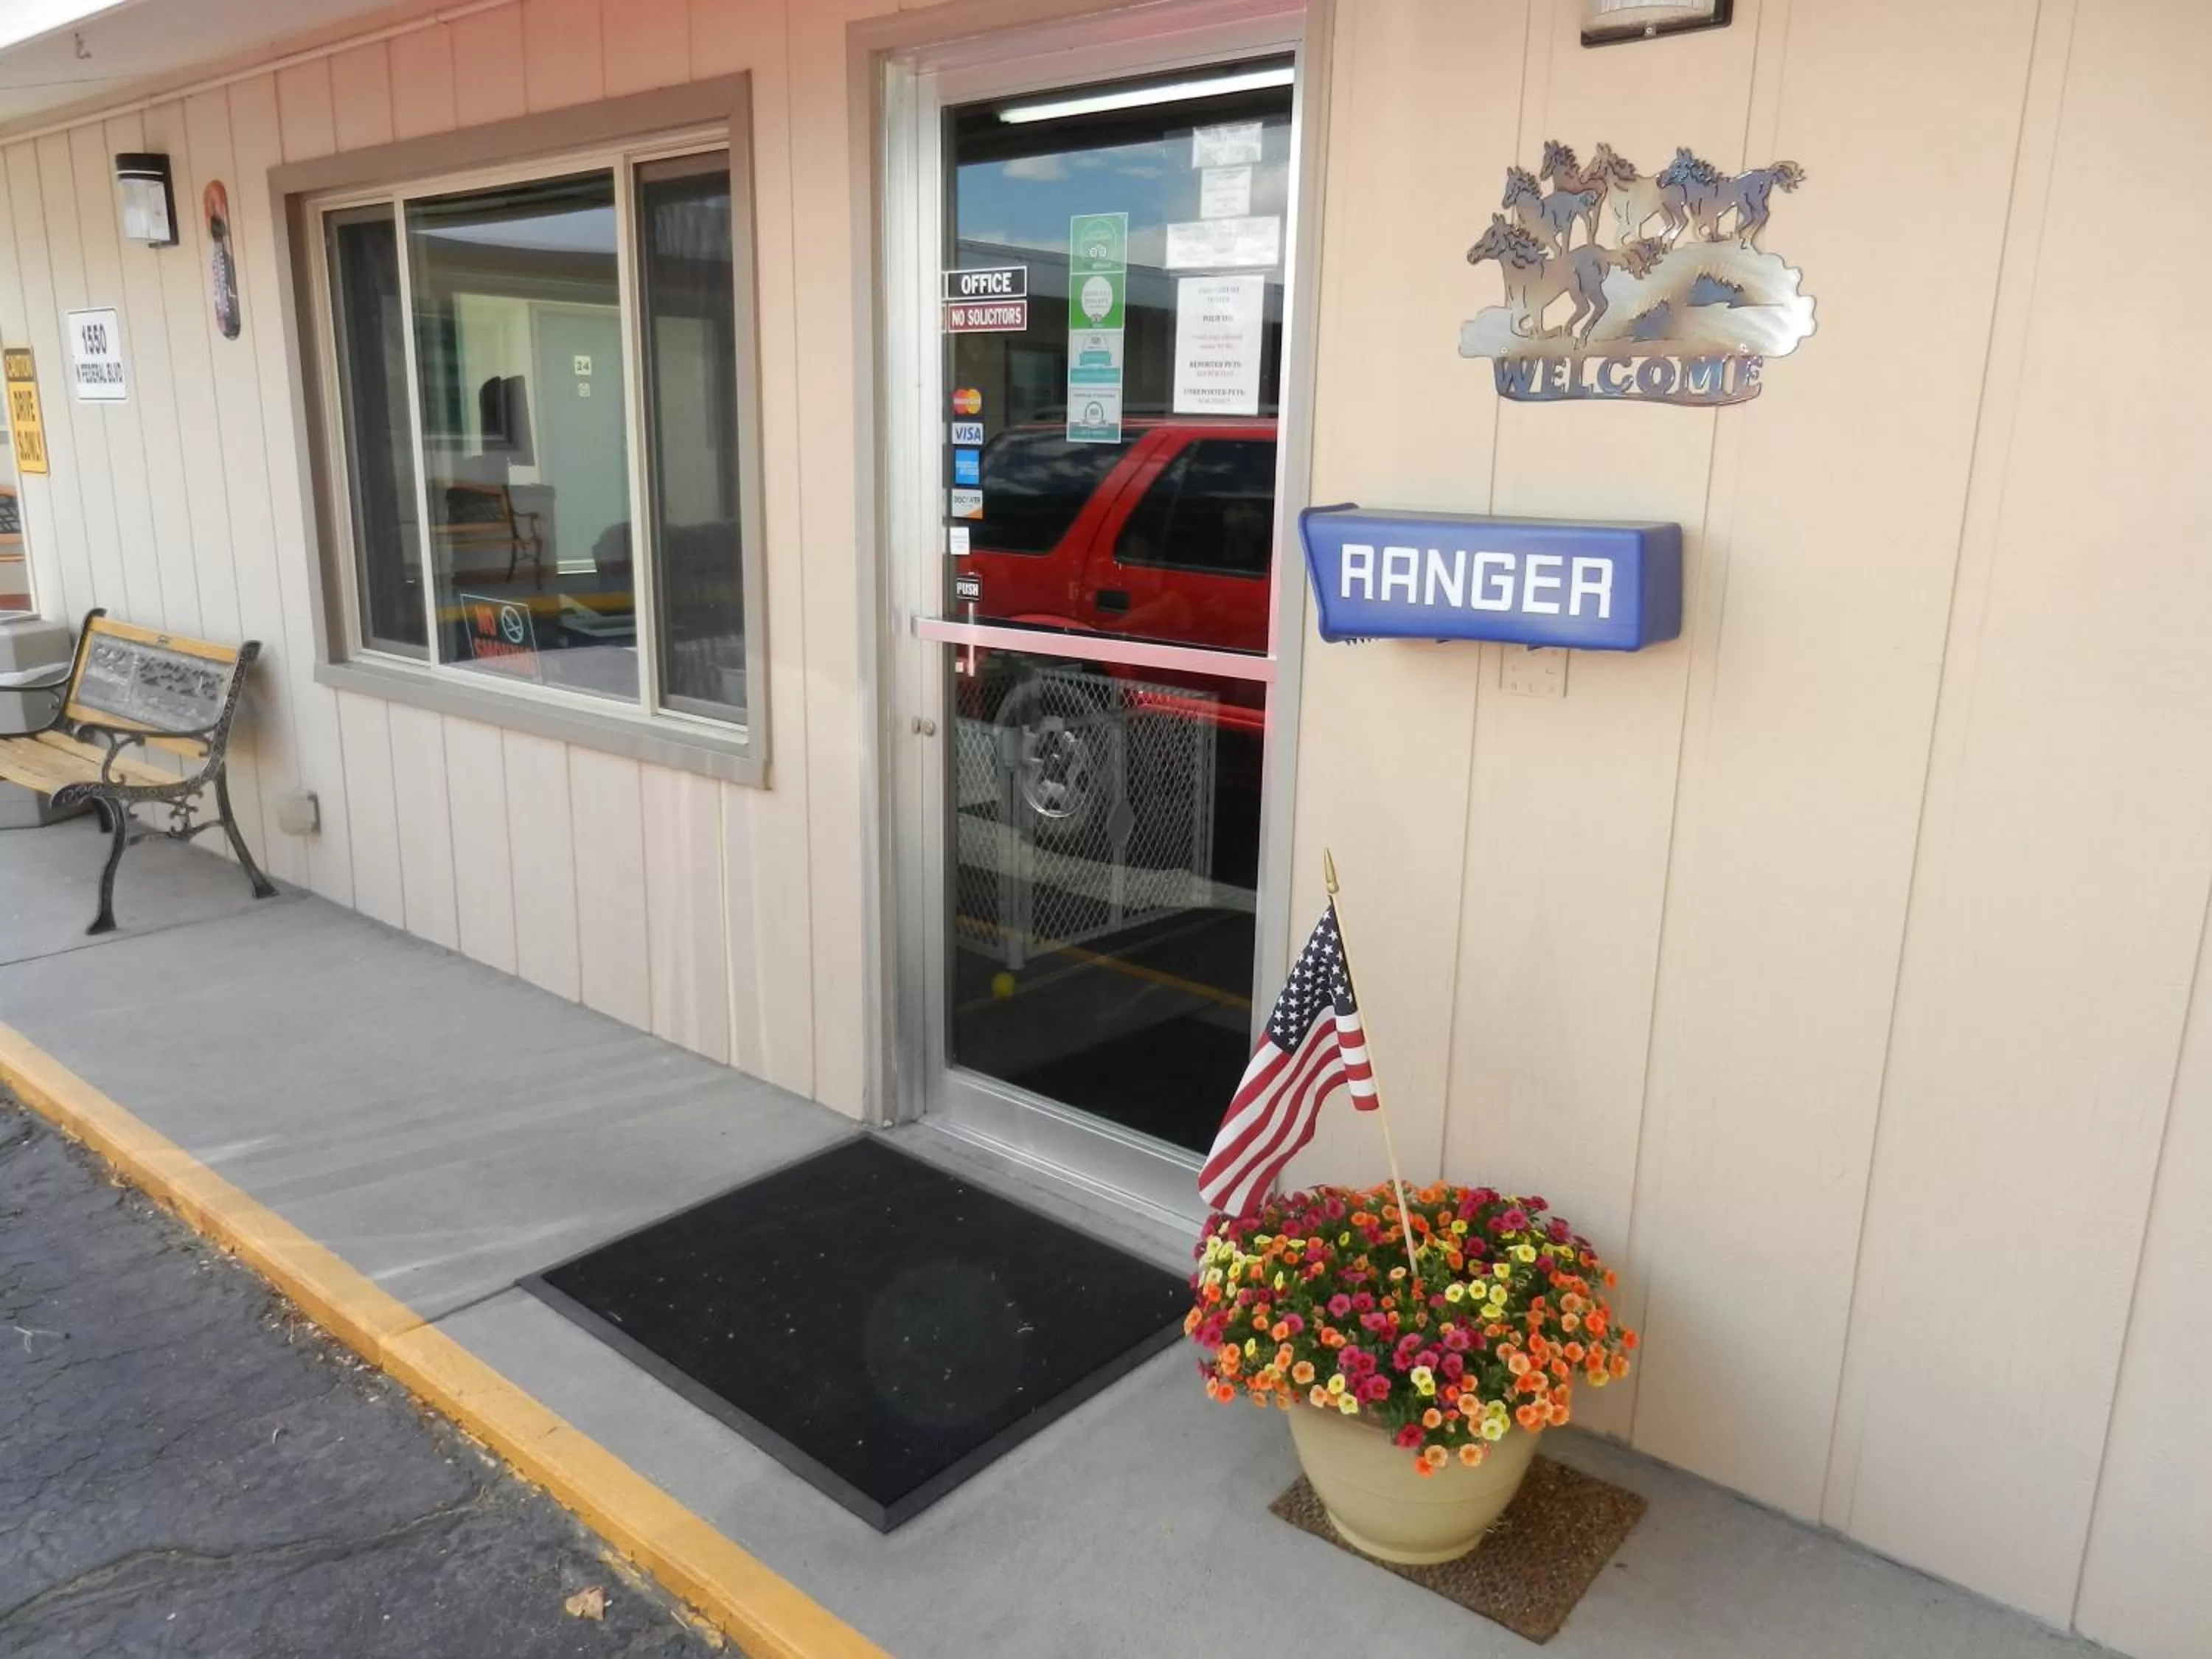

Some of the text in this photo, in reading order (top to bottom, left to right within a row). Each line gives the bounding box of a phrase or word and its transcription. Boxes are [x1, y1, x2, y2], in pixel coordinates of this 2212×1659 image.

[961, 272, 1012, 294] OFFICE
[952, 307, 1021, 327] NO SOLICITORS
[82, 324, 107, 354] 1550
[1494, 355, 1764, 396] WELCOME
[956, 427, 981, 441] VISA
[956, 581, 979, 596] PUSH
[1340, 543, 1613, 619] RANGER
[475, 605, 497, 636] NO
